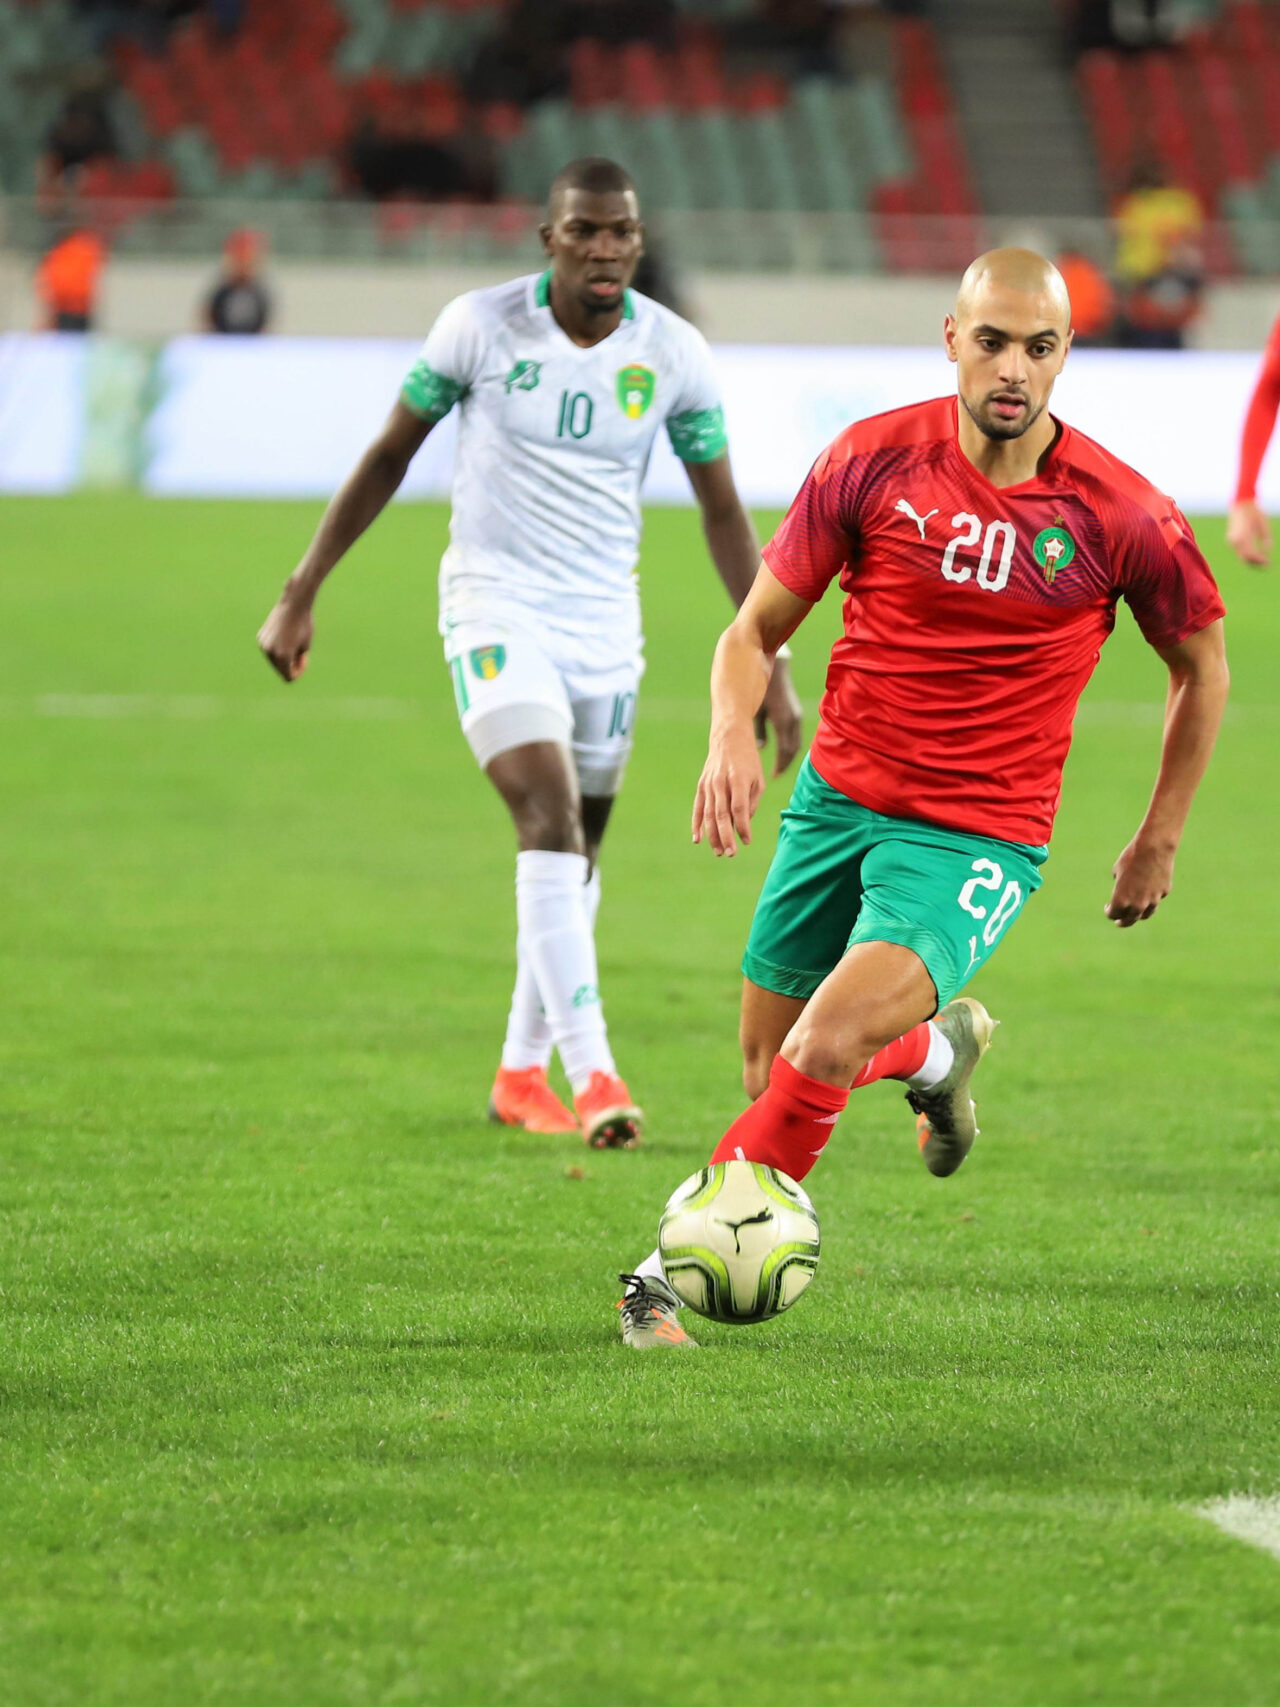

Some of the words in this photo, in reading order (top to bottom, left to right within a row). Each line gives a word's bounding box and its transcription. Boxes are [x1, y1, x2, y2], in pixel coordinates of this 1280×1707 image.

[557, 389, 594, 439] 10
[940, 511, 1017, 592] 20
[957, 857, 1022, 947] 20
